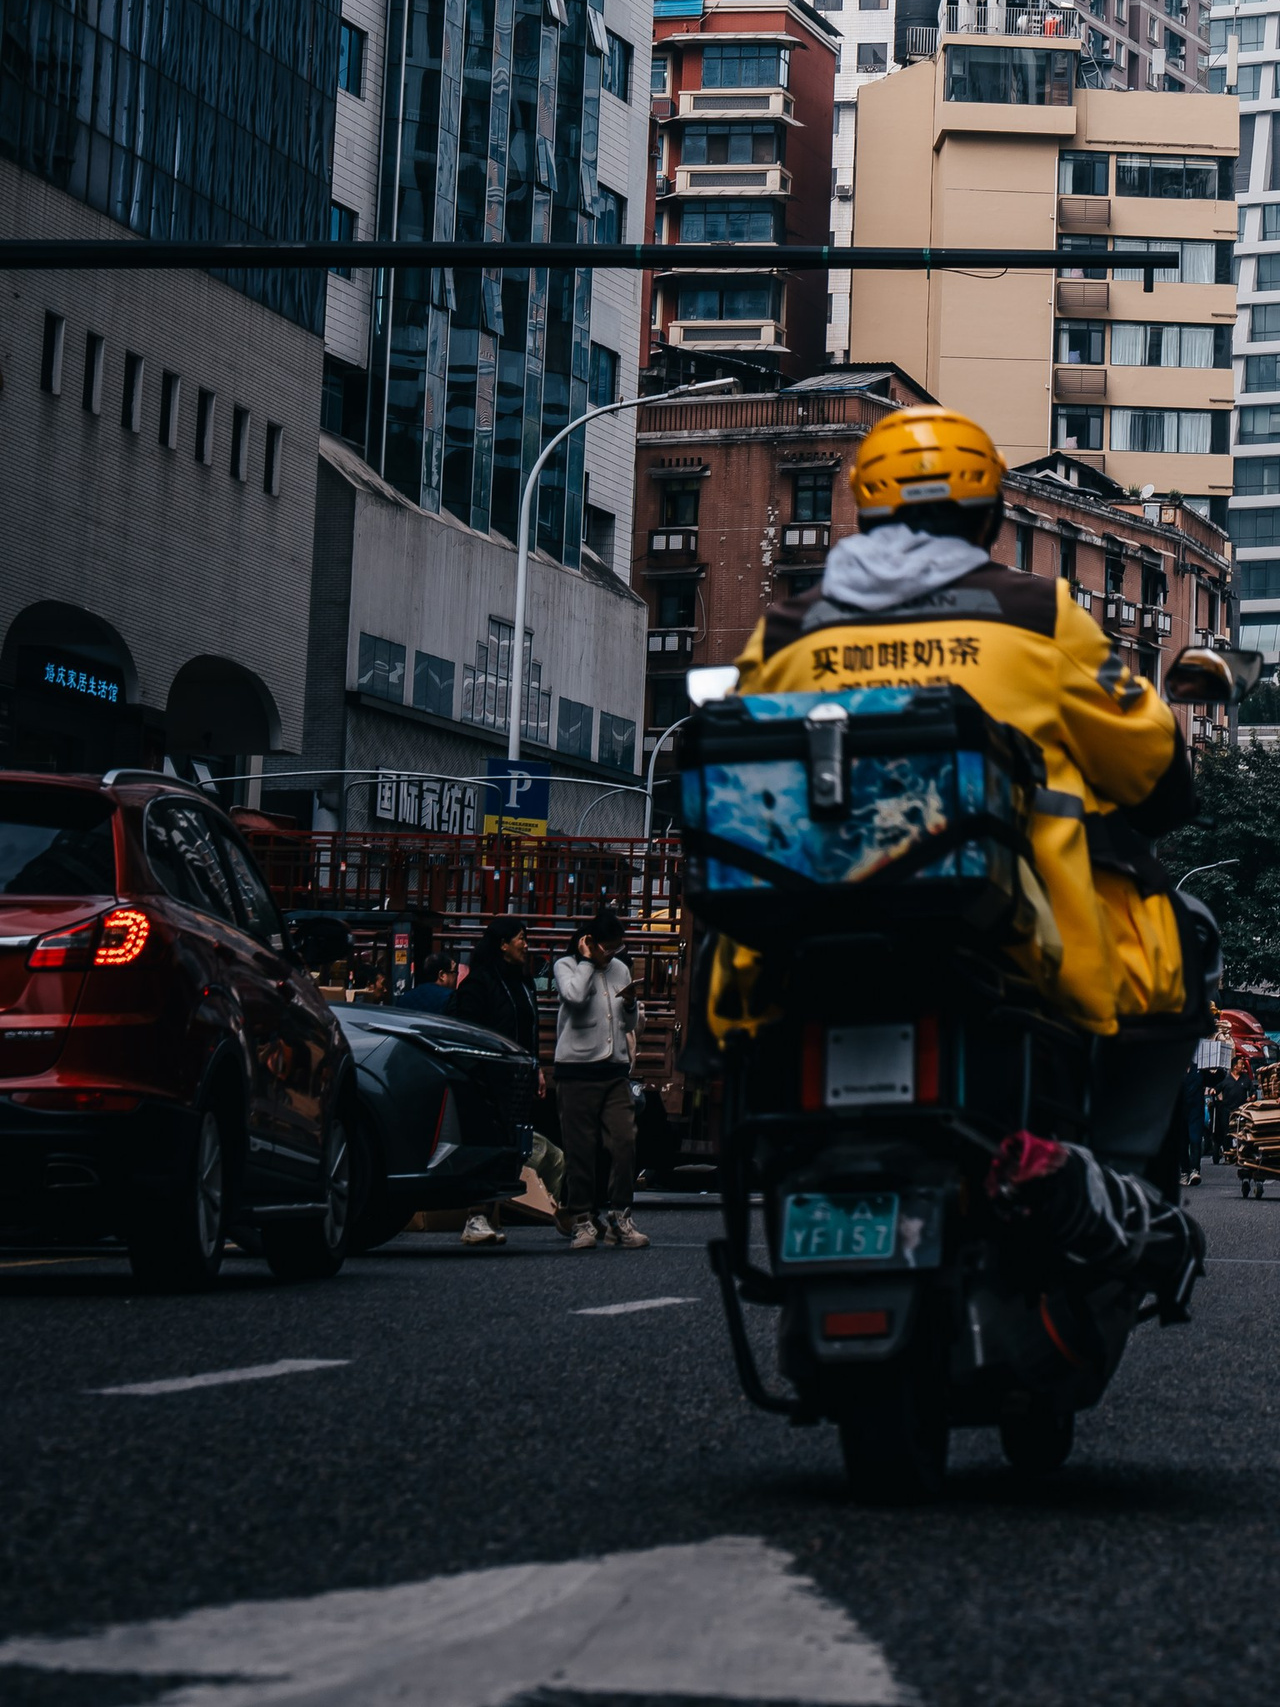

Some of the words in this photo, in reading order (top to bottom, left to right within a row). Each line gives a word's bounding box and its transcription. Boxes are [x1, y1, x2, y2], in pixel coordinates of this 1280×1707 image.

[811, 637, 981, 680] 买咖啡奶茶
[44, 662, 119, 703] 婚庆家居生活馆
[504, 769, 533, 809] P
